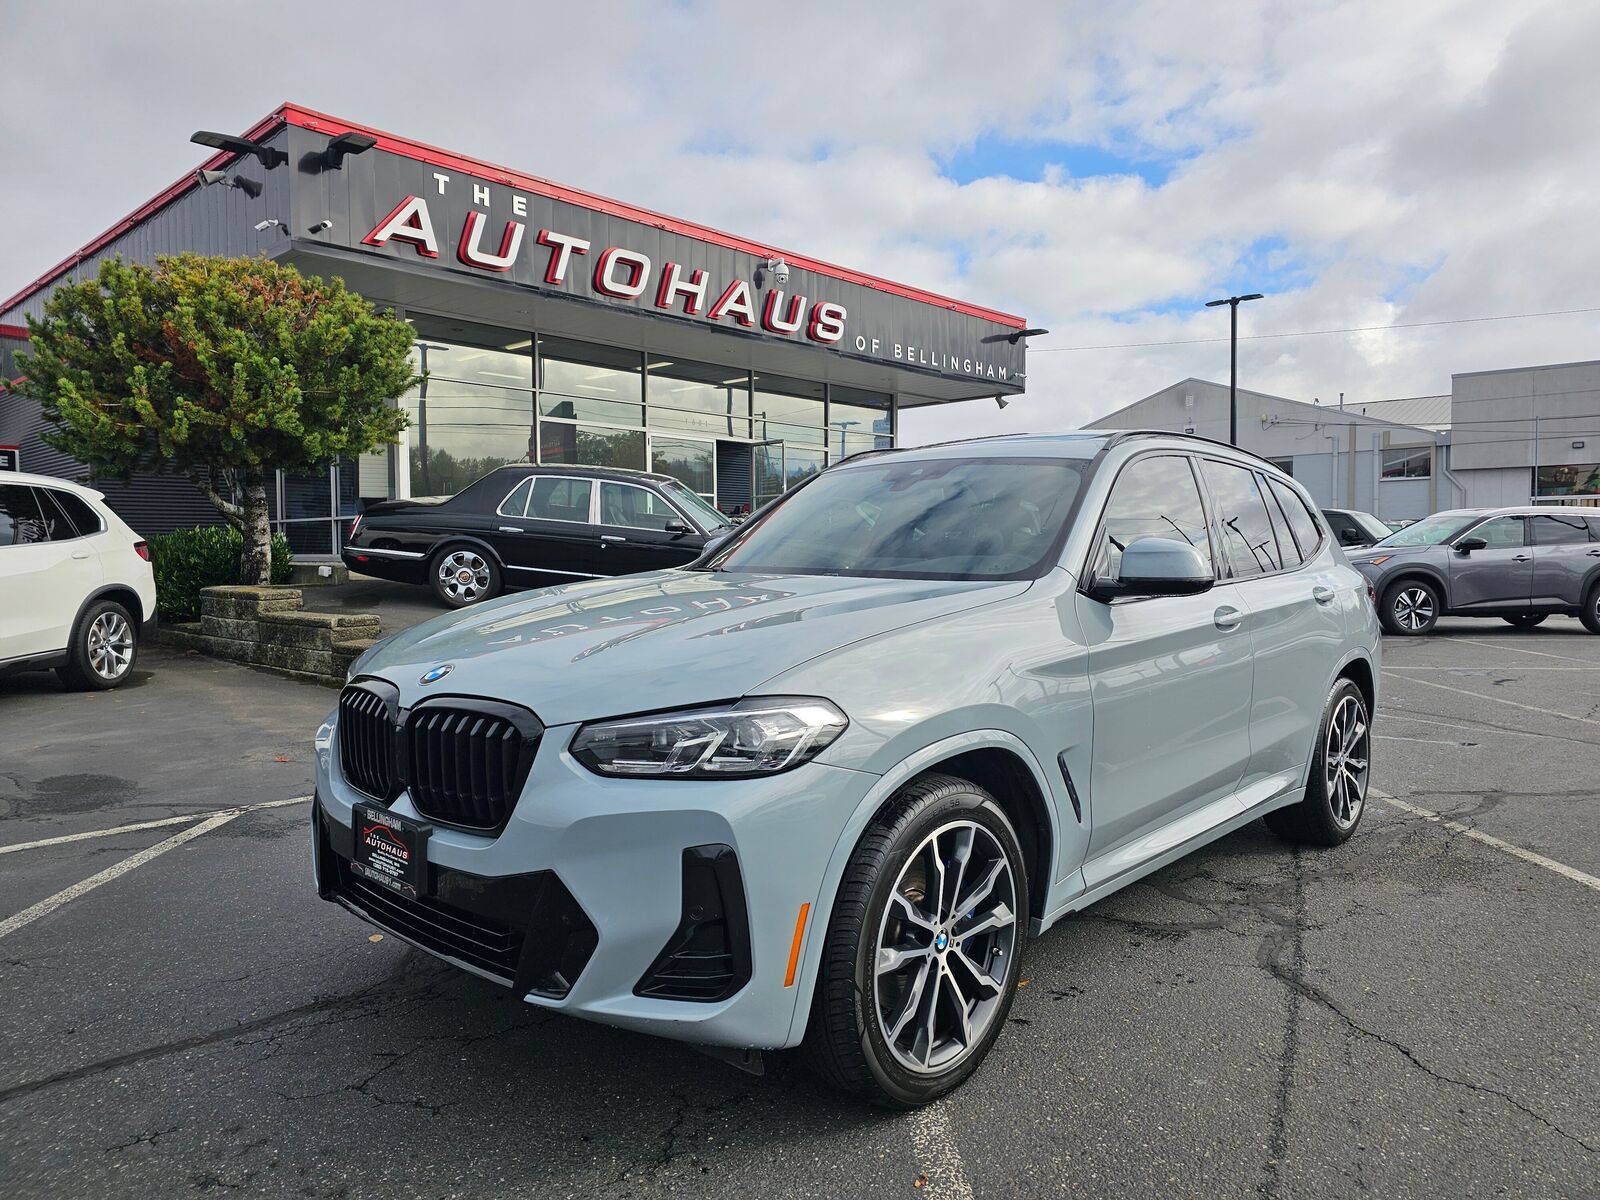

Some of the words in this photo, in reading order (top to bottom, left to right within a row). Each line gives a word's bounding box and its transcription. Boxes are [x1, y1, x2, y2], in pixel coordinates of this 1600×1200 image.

[433, 173, 528, 217] THE
[361, 194, 847, 344] AUTOHAUS
[855, 335, 880, 353] OF
[894, 343, 1007, 380] BELLINGHAM
[366, 837, 408, 859] AUTOHAUS
